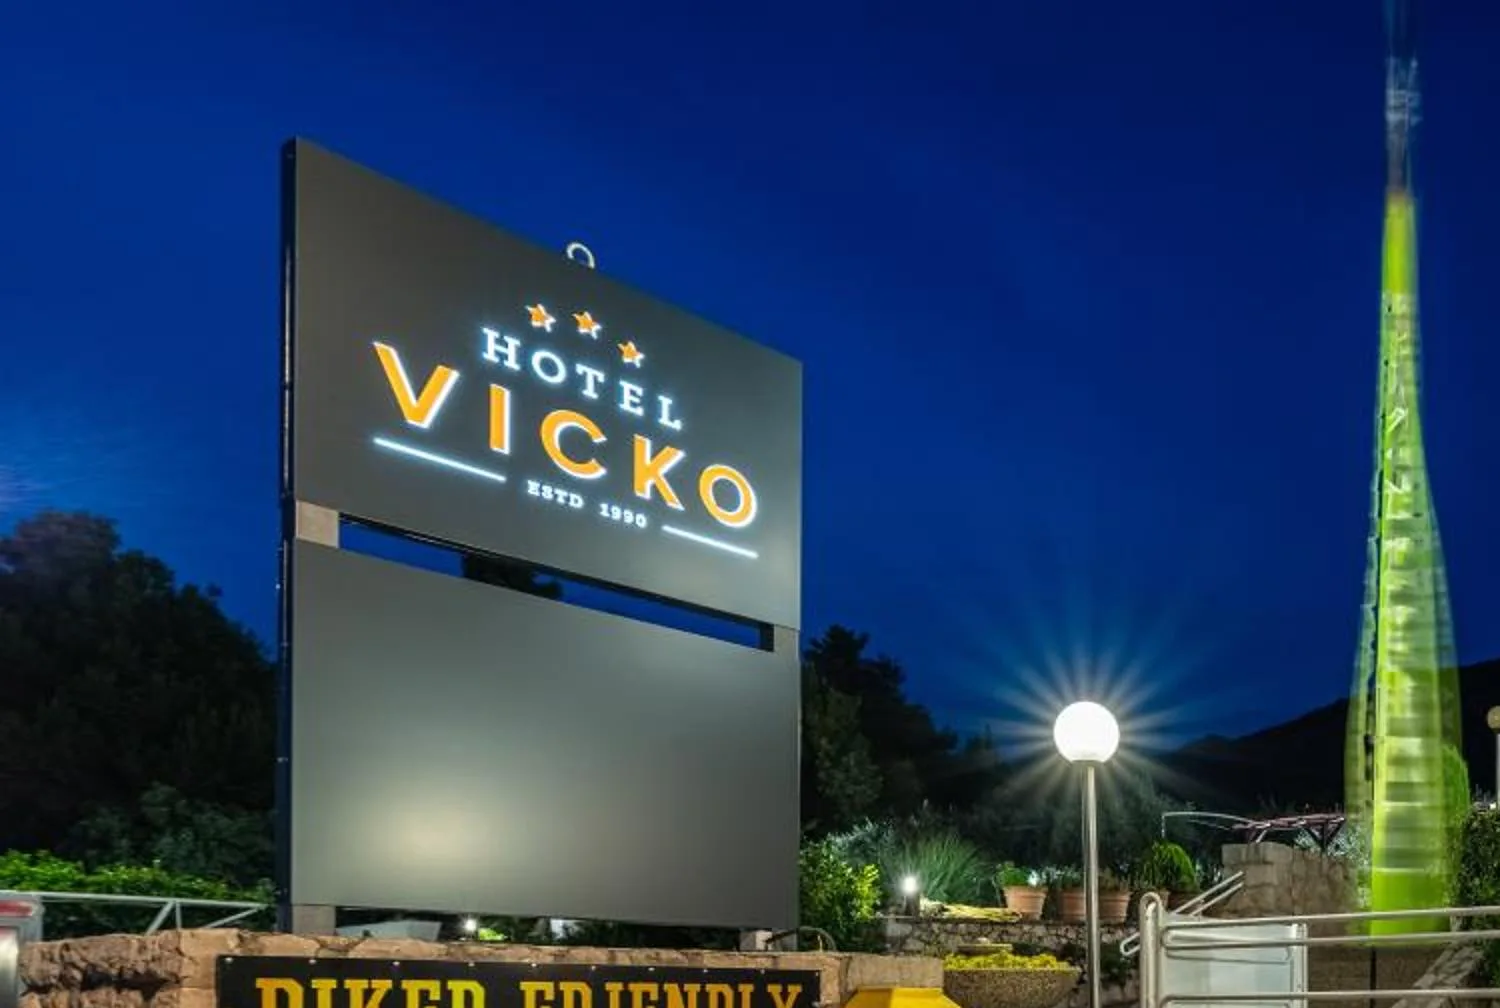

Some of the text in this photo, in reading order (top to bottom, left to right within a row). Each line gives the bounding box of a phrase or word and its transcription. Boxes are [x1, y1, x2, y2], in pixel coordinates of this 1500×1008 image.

[482, 327, 684, 431] HOTEL
[373, 341, 758, 529] VICKO
[527, 480, 648, 528] ESTD 1990
